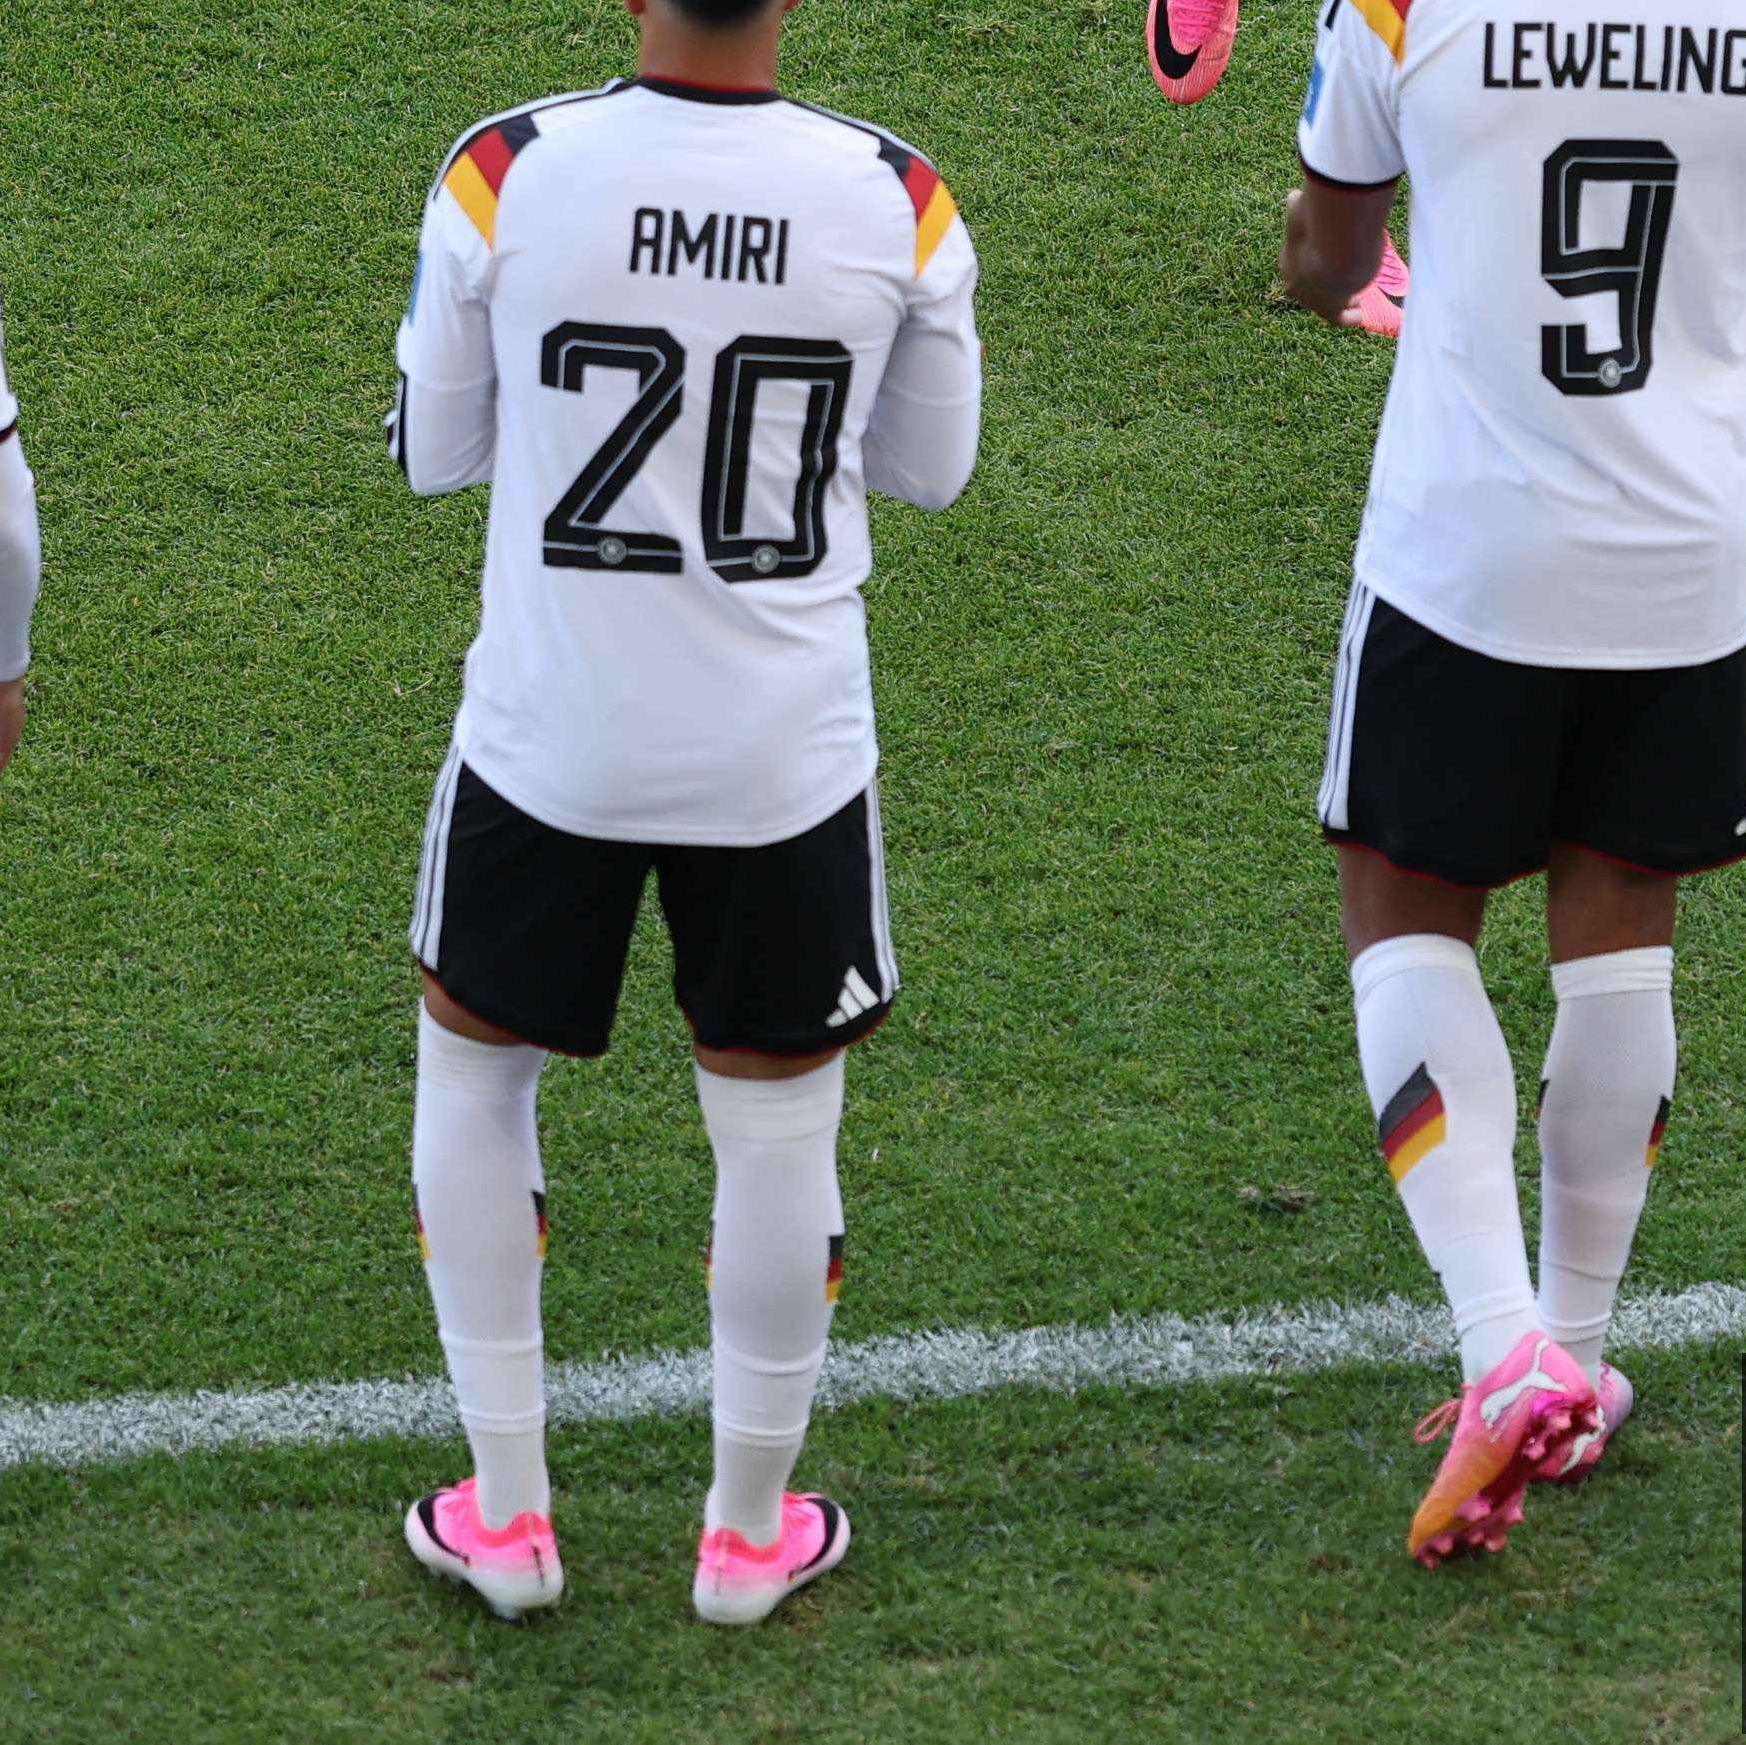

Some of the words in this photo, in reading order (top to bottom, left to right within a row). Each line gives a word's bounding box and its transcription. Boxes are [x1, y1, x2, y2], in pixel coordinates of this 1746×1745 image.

[629, 207, 789, 286] AMIRI
[1540, 139, 1680, 397] 9
[540, 320, 854, 583] 20
